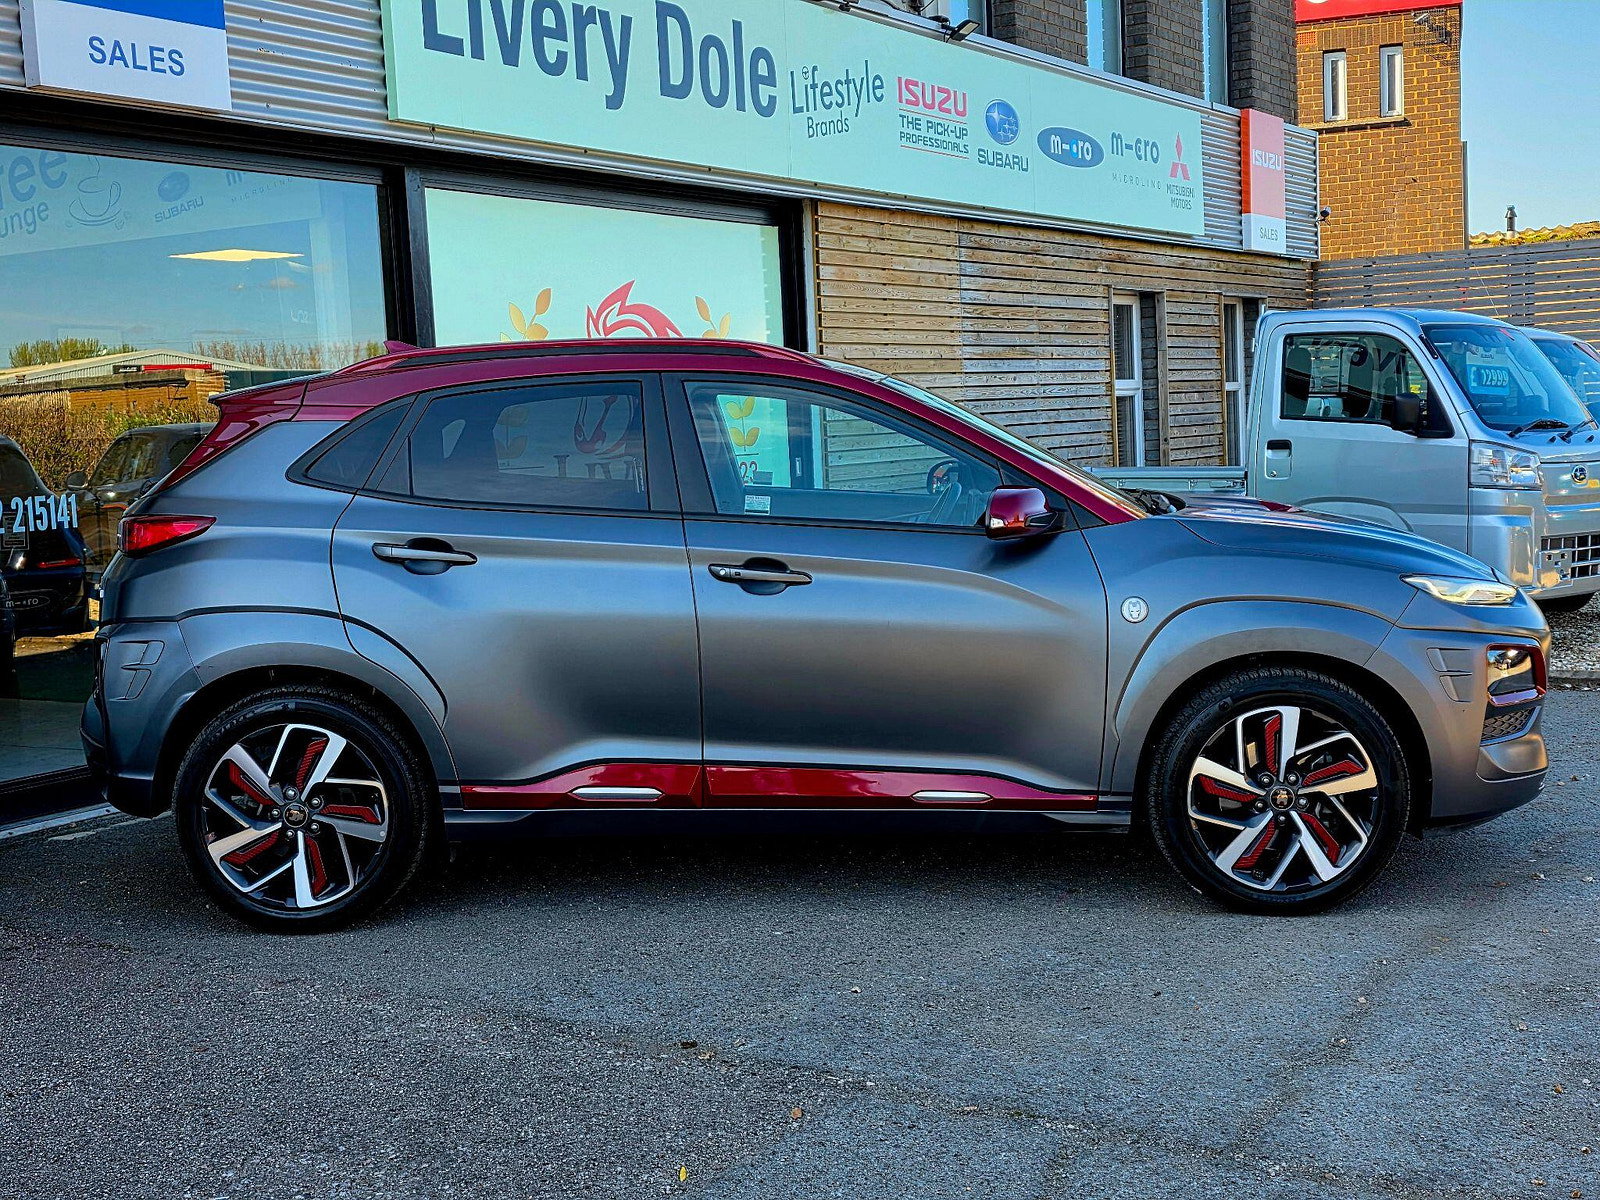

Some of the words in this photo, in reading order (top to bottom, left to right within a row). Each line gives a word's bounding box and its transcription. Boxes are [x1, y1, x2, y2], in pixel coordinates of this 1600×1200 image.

[88, 36, 186, 77] SALES
[655, 0, 778, 118] Dole
[790, 59, 886, 118] Lifestyle
[897, 76, 968, 118] ISUZU
[807, 111, 850, 139] Brands
[899, 114, 922, 132] THE
[926, 119, 969, 140] PICK-UP
[899, 130, 970, 154] PROFESSIONALS
[977, 148, 1030, 172] SUBARU
[1252, 148, 1283, 171] ISUZU
[154, 195, 205, 223] SUBARU
[1171, 196, 1193, 211] MOTORS
[1259, 227, 1279, 241] SALES
[1481, 368, 1509, 387] 12999
[10, 493, 79, 533] 215141
